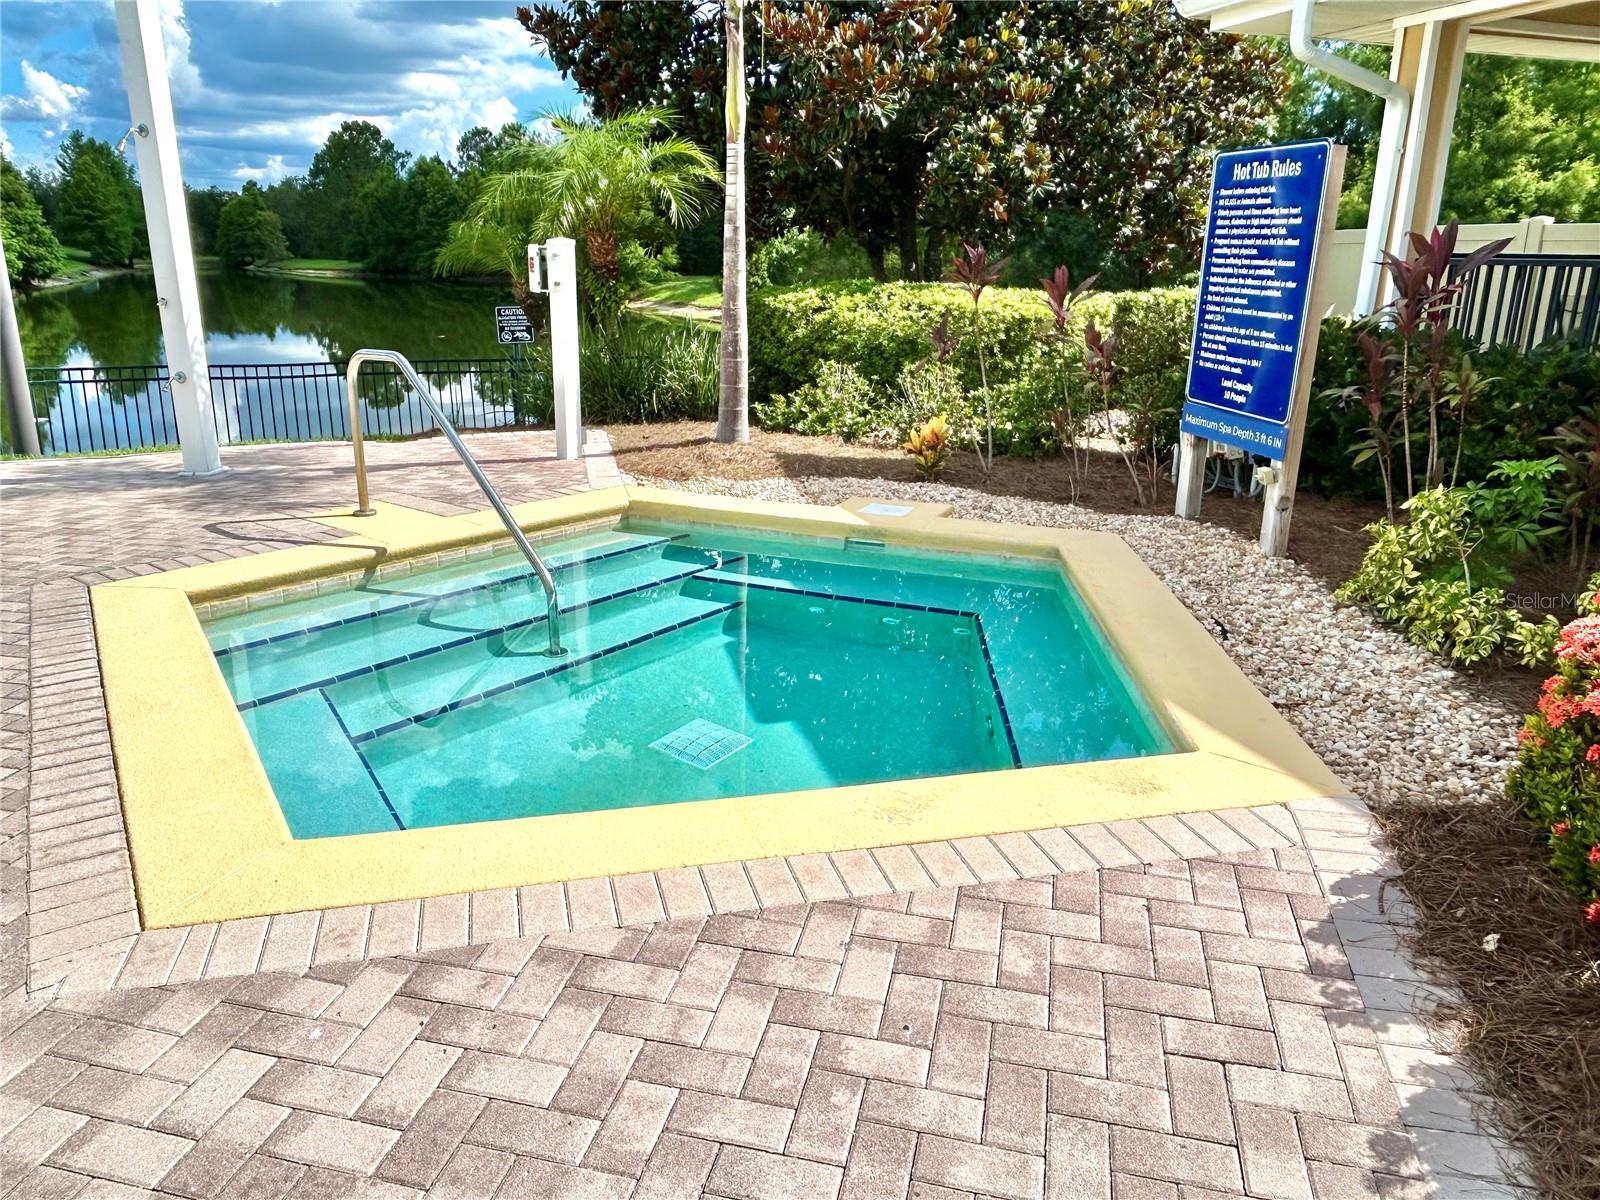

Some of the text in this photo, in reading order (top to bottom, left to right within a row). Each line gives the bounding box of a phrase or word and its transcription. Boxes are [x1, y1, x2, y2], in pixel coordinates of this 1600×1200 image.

[1233, 159, 1301, 180] Hot Tub Rules
[1221, 378, 1253, 394] Load Capacity
[1224, 390, 1246, 403] 10 People
[1185, 413, 1282, 448] Maximum Spa Depth 3 ft 6 IN
